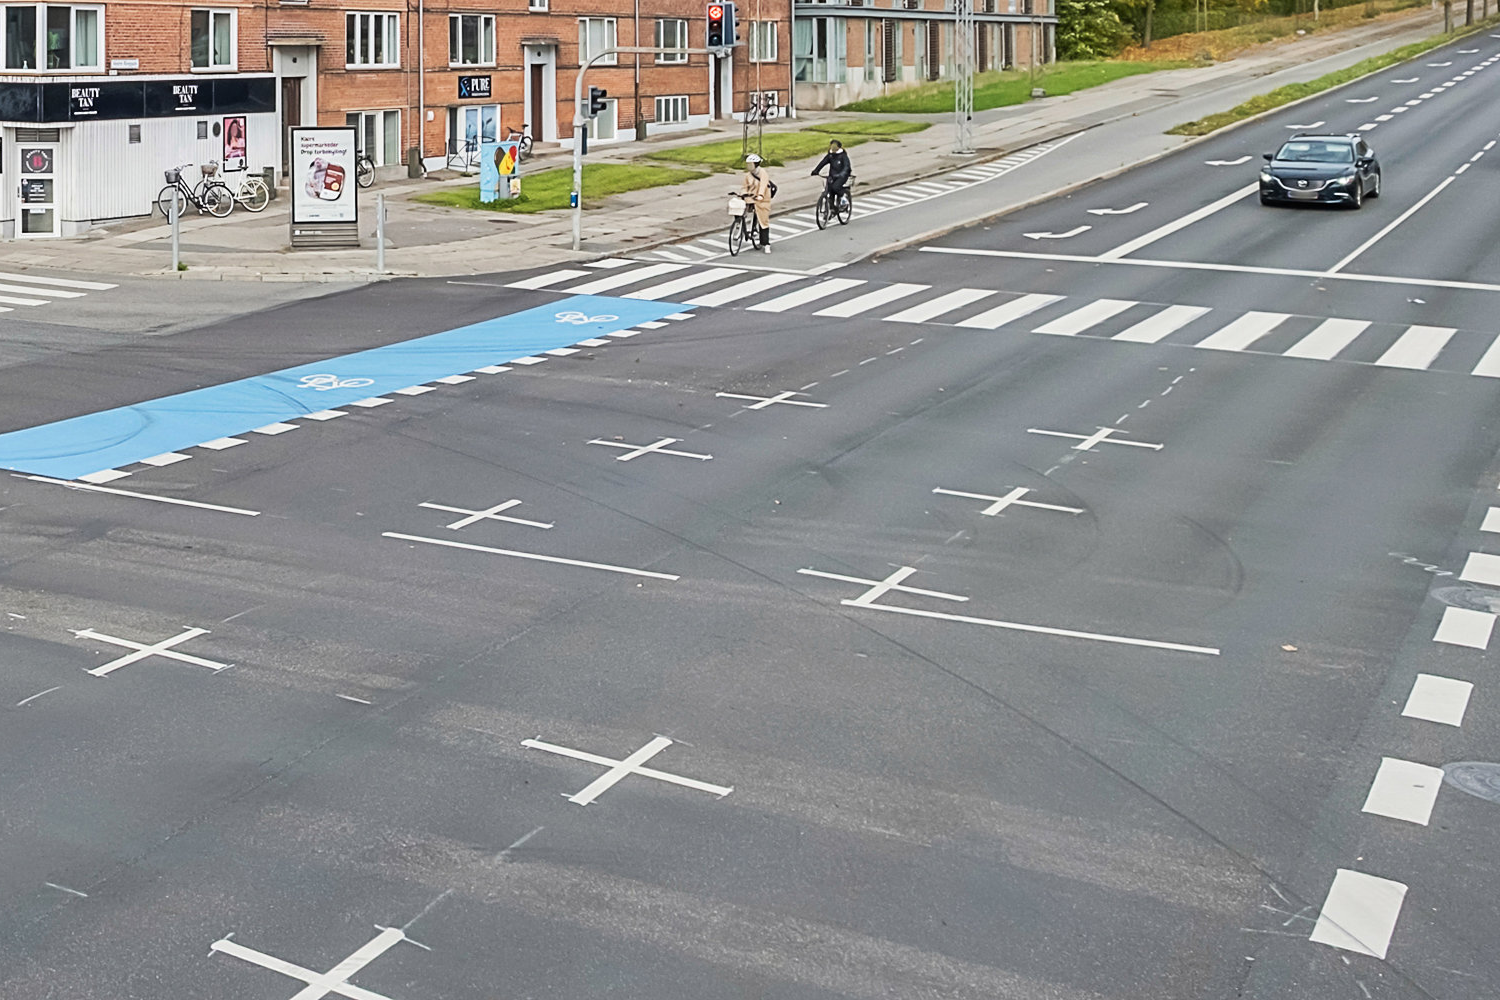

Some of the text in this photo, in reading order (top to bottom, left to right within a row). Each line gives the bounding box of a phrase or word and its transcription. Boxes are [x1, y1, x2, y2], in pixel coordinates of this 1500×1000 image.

[172, 84, 199, 95] BEAUTY
[471, 77, 490, 91] PURE
[71, 87, 100, 99] BEAUTY
[77, 97, 94, 107] TAN
[179, 94, 193, 104] TAN
